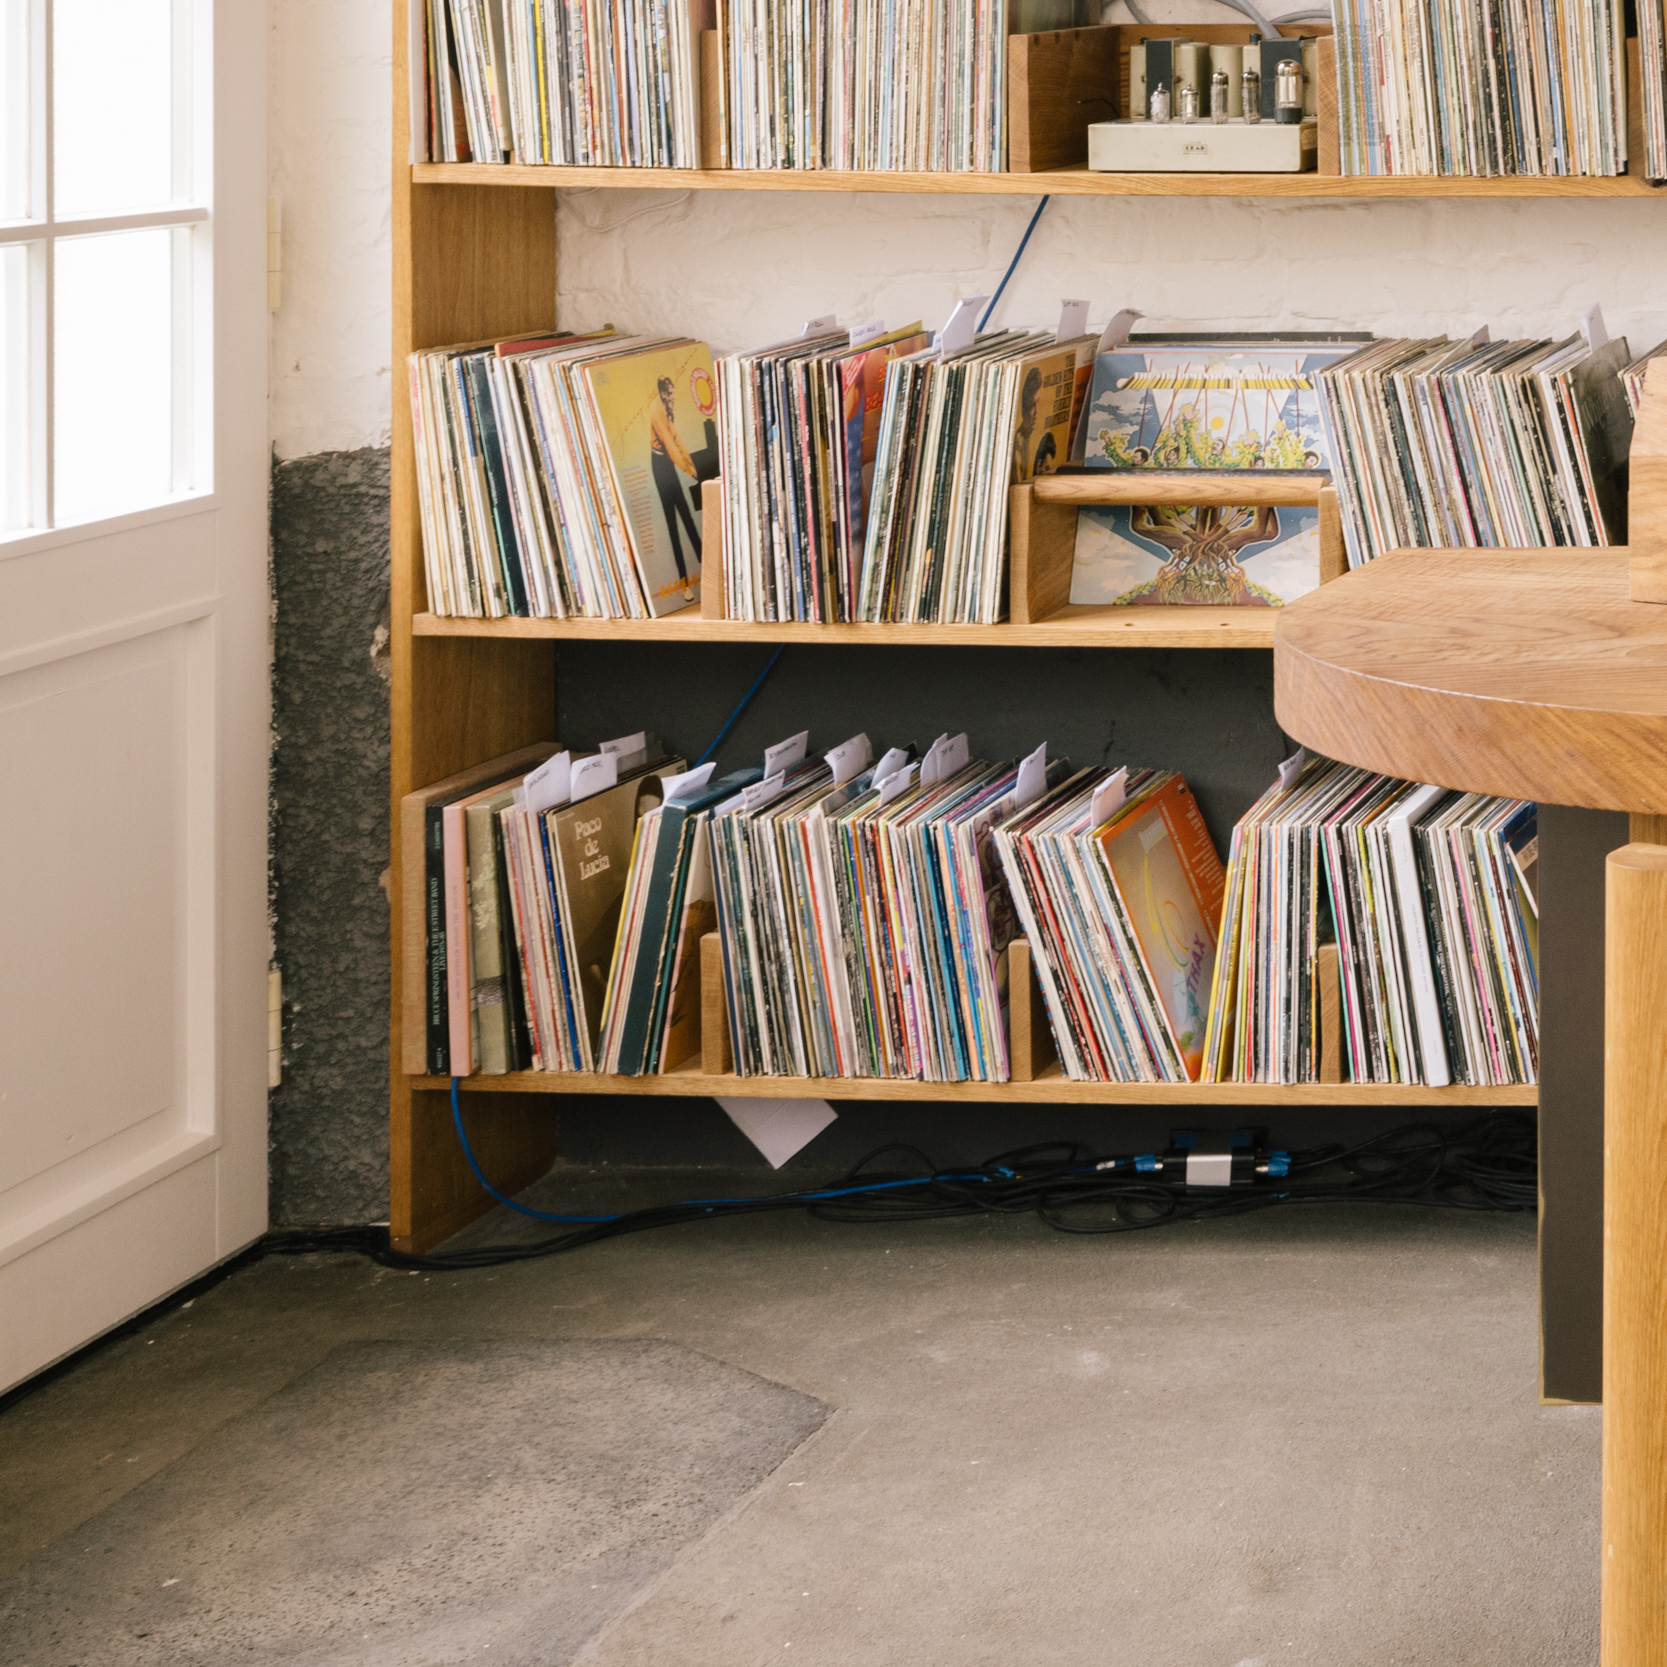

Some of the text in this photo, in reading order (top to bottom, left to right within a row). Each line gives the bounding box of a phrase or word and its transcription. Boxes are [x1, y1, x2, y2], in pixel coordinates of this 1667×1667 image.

[573, 817, 602, 841] Paco
[584, 838, 599, 857] de
[429, 877, 438, 897] BAND
[430, 898, 439, 925] STREET
[431, 955, 440, 1003] SPRINGSTEEN
[432, 1003, 441, 1025] BRUCE
